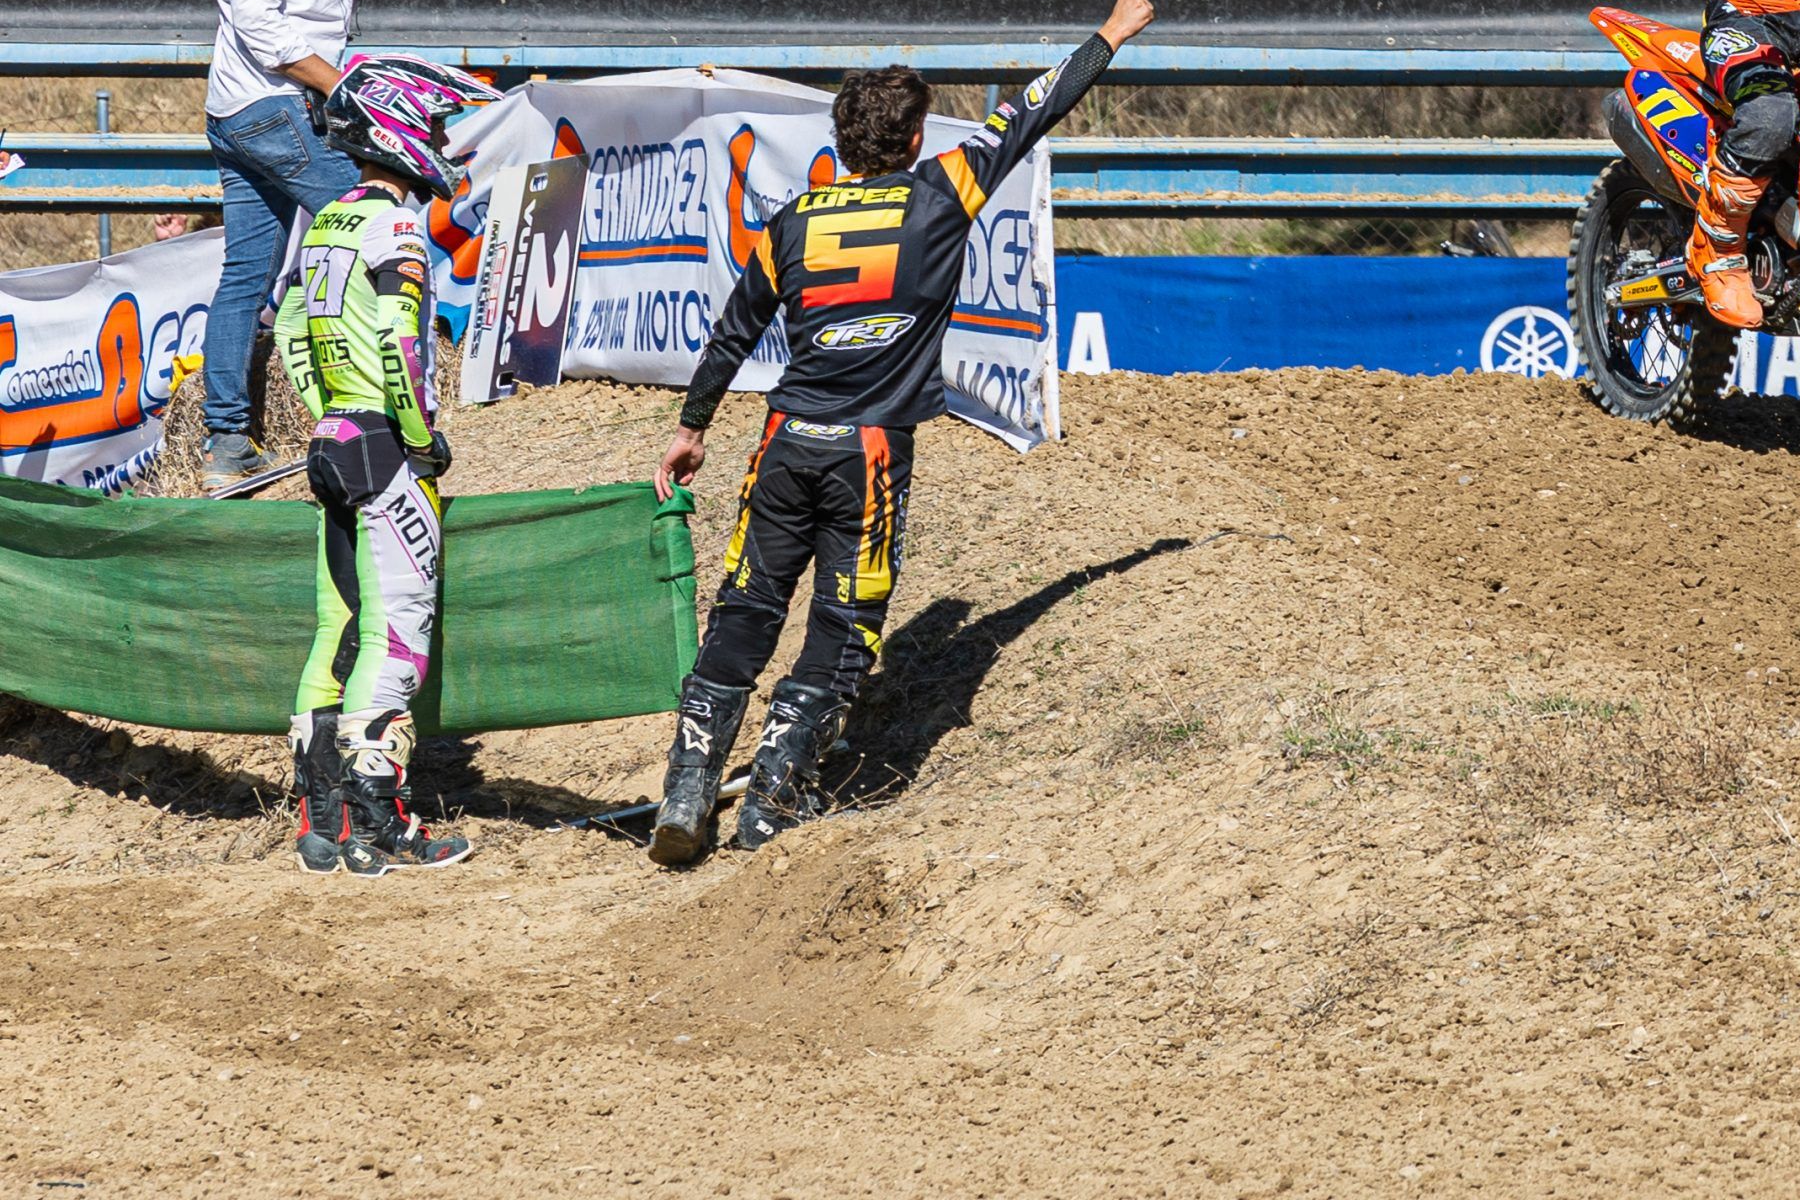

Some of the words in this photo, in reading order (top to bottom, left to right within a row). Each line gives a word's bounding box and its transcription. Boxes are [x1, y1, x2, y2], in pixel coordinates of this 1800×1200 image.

[373, 129, 399, 150] BELL
[1636, 87, 1700, 131] 17
[583, 138, 707, 243] ERMUDEZ
[394, 222, 416, 233] EK
[802, 208, 905, 308] 5
[499, 198, 537, 366] VUELTAS
[518, 229, 571, 333] 2
[318, 338, 351, 363] OTS
[633, 289, 712, 353] MOTOS
[376, 327, 413, 410] MOTS
